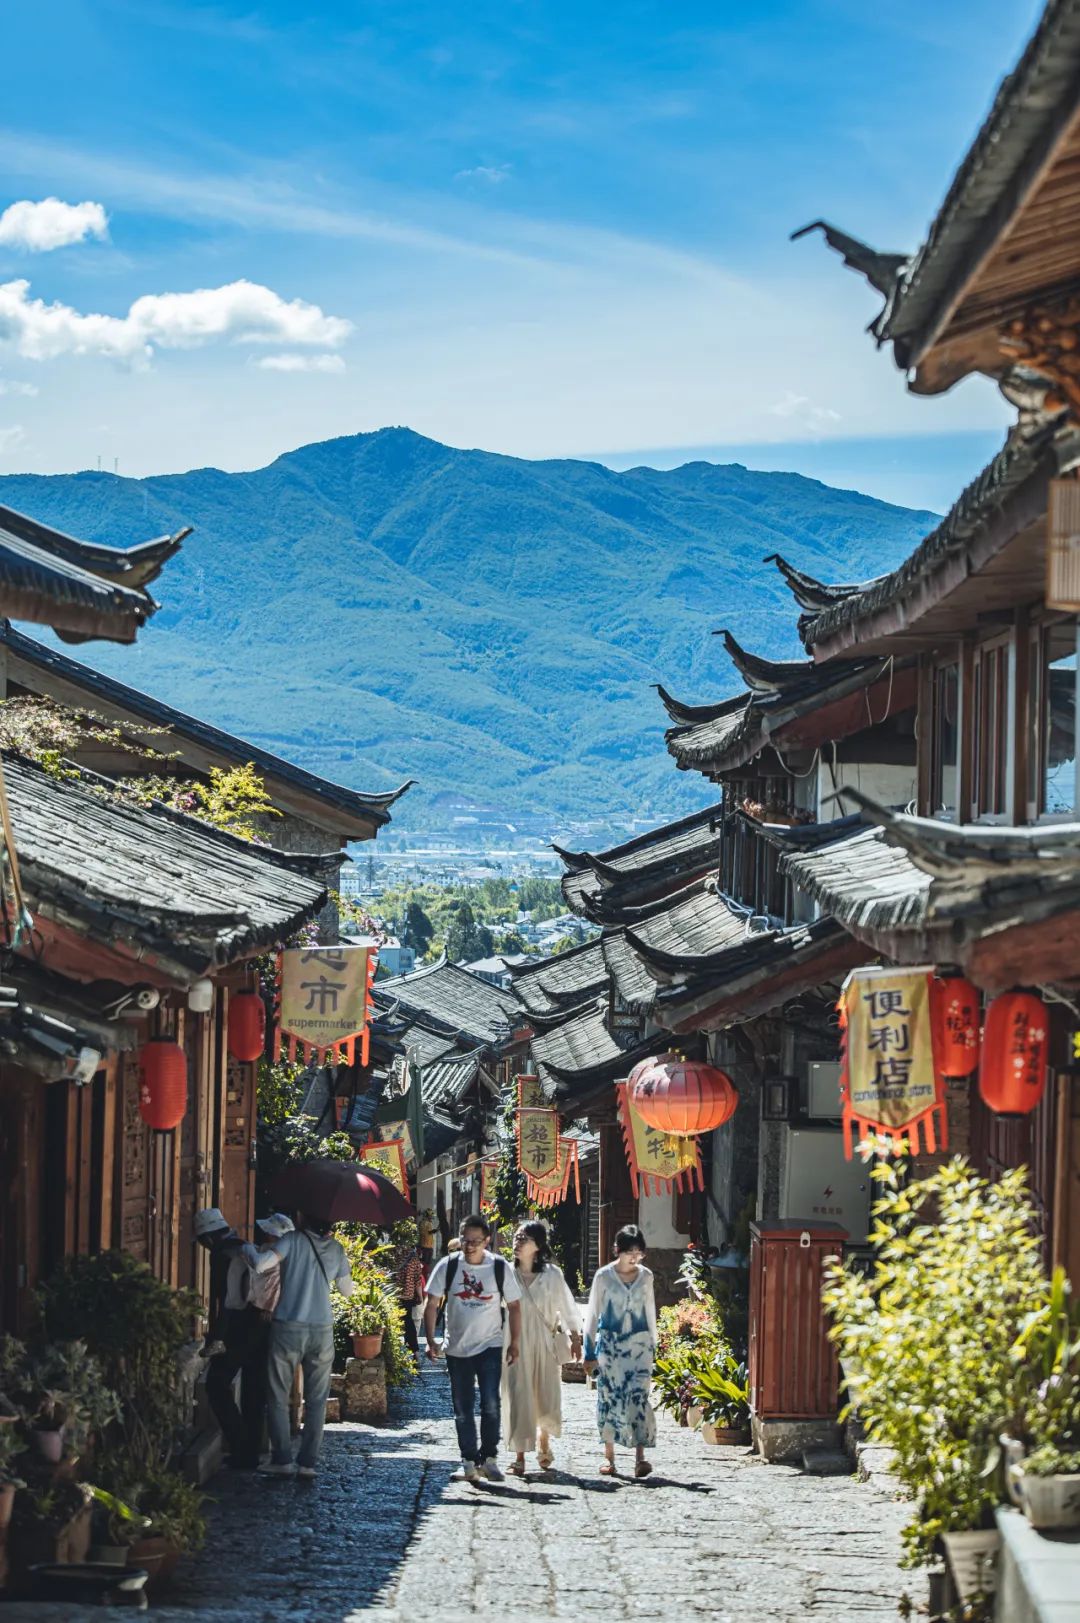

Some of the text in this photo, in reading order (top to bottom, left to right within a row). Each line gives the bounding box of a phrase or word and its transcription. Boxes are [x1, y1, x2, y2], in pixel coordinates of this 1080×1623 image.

[288, 1018, 358, 1029] supermarket
[863, 989, 913, 1087] 便利店
[524, 1123, 552, 1170] 超市
